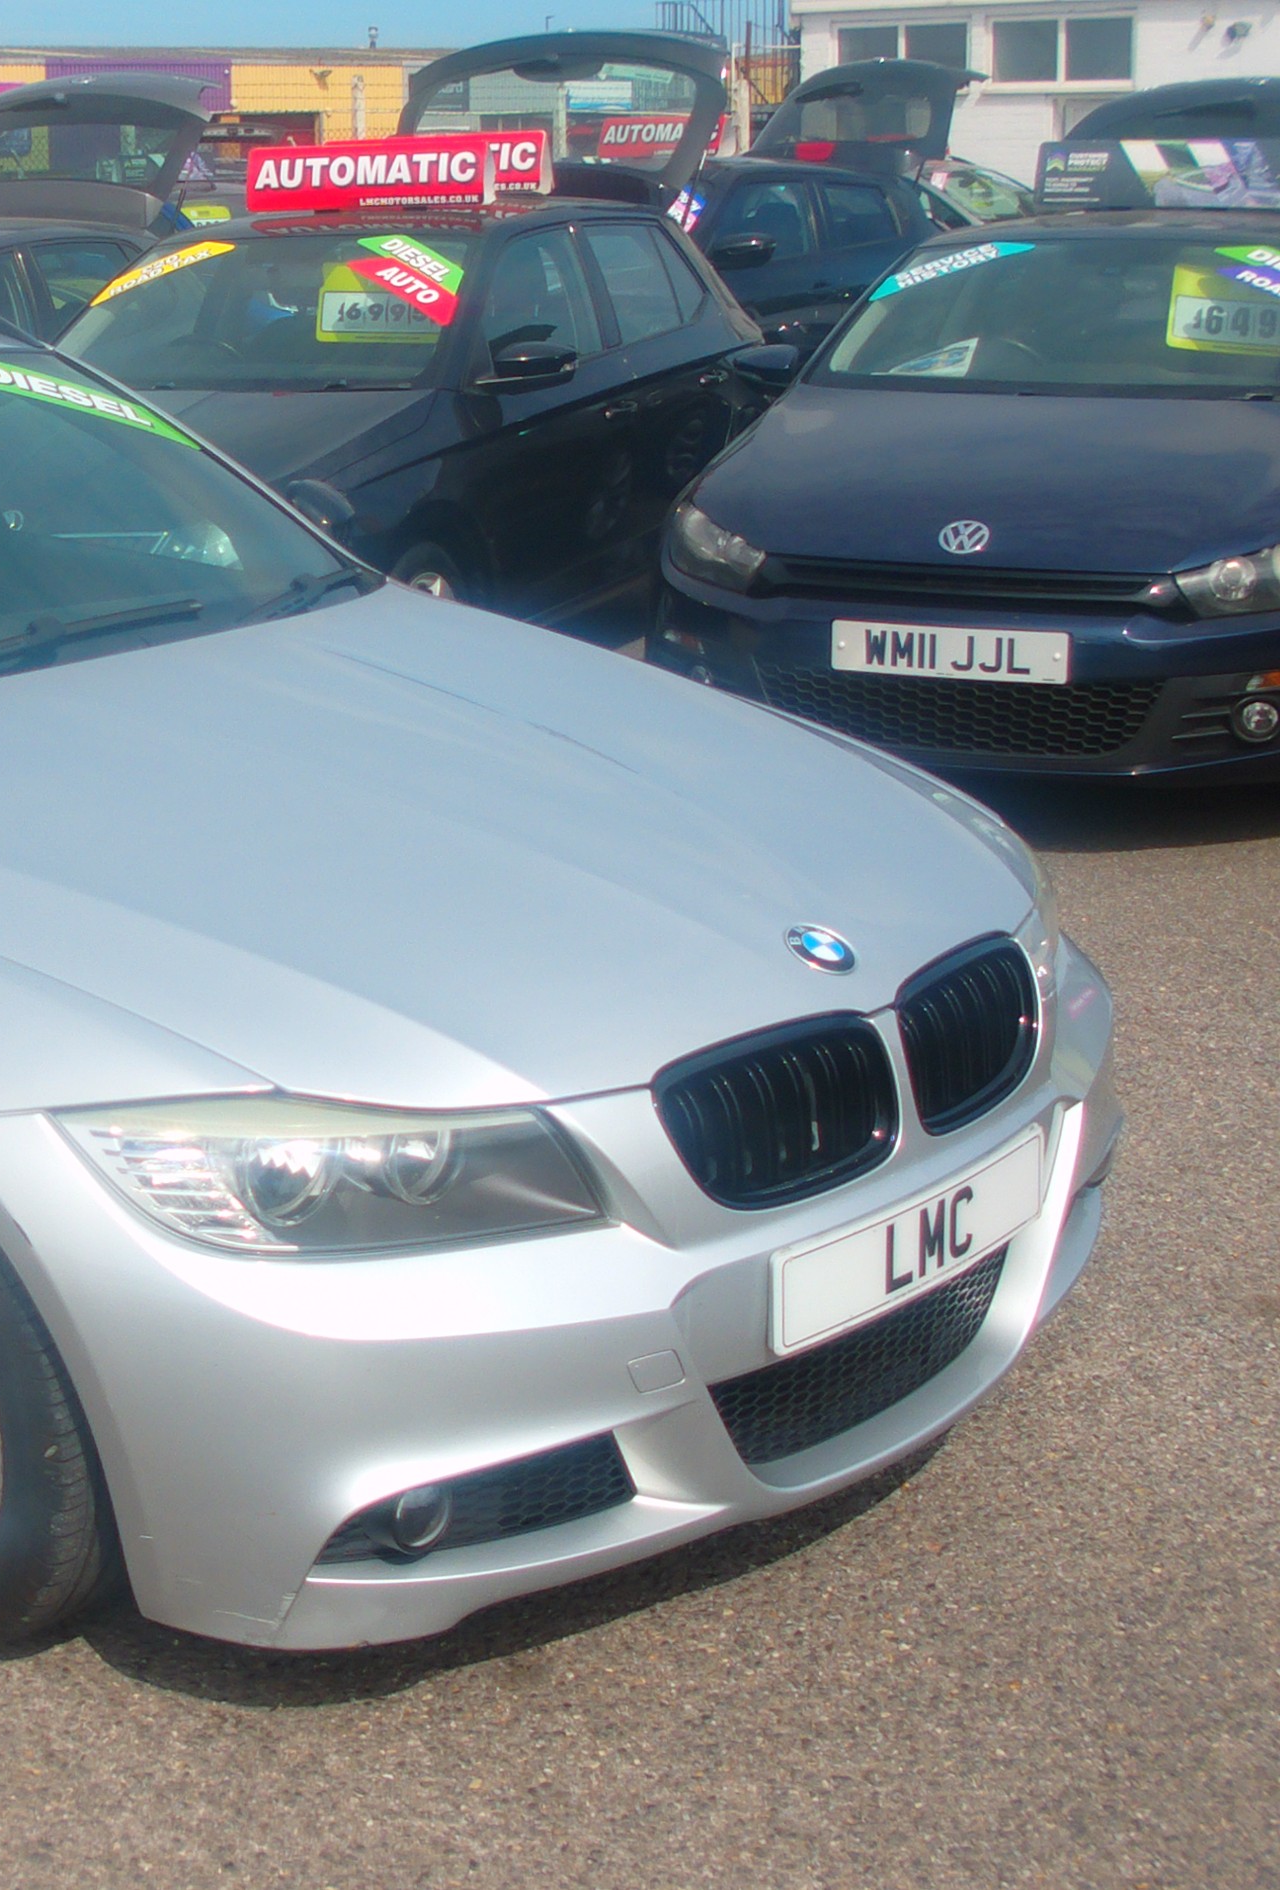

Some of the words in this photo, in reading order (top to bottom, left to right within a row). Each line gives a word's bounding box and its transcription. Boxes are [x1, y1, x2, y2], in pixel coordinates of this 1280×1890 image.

[603, 123, 719, 145] AUTOMA
[254, 150, 477, 190] AUTOMATIC
[489, 141, 537, 171] IC
[358, 194, 480, 207] LMCMOTORSALES.CO.UK
[109, 267, 165, 297] ROAD
[172, 248, 213, 269] TAX
[379, 238, 451, 283] DIESEL
[894, 242, 999, 281] SERVICE
[897, 248, 1000, 289] HISTORY
[1246, 249, 1280, 272] DI
[375, 266, 440, 304] AUTO
[864, 628, 937, 670] WM11
[950, 635, 1031, 676] JJL
[885, 1185, 974, 1295] LMC
